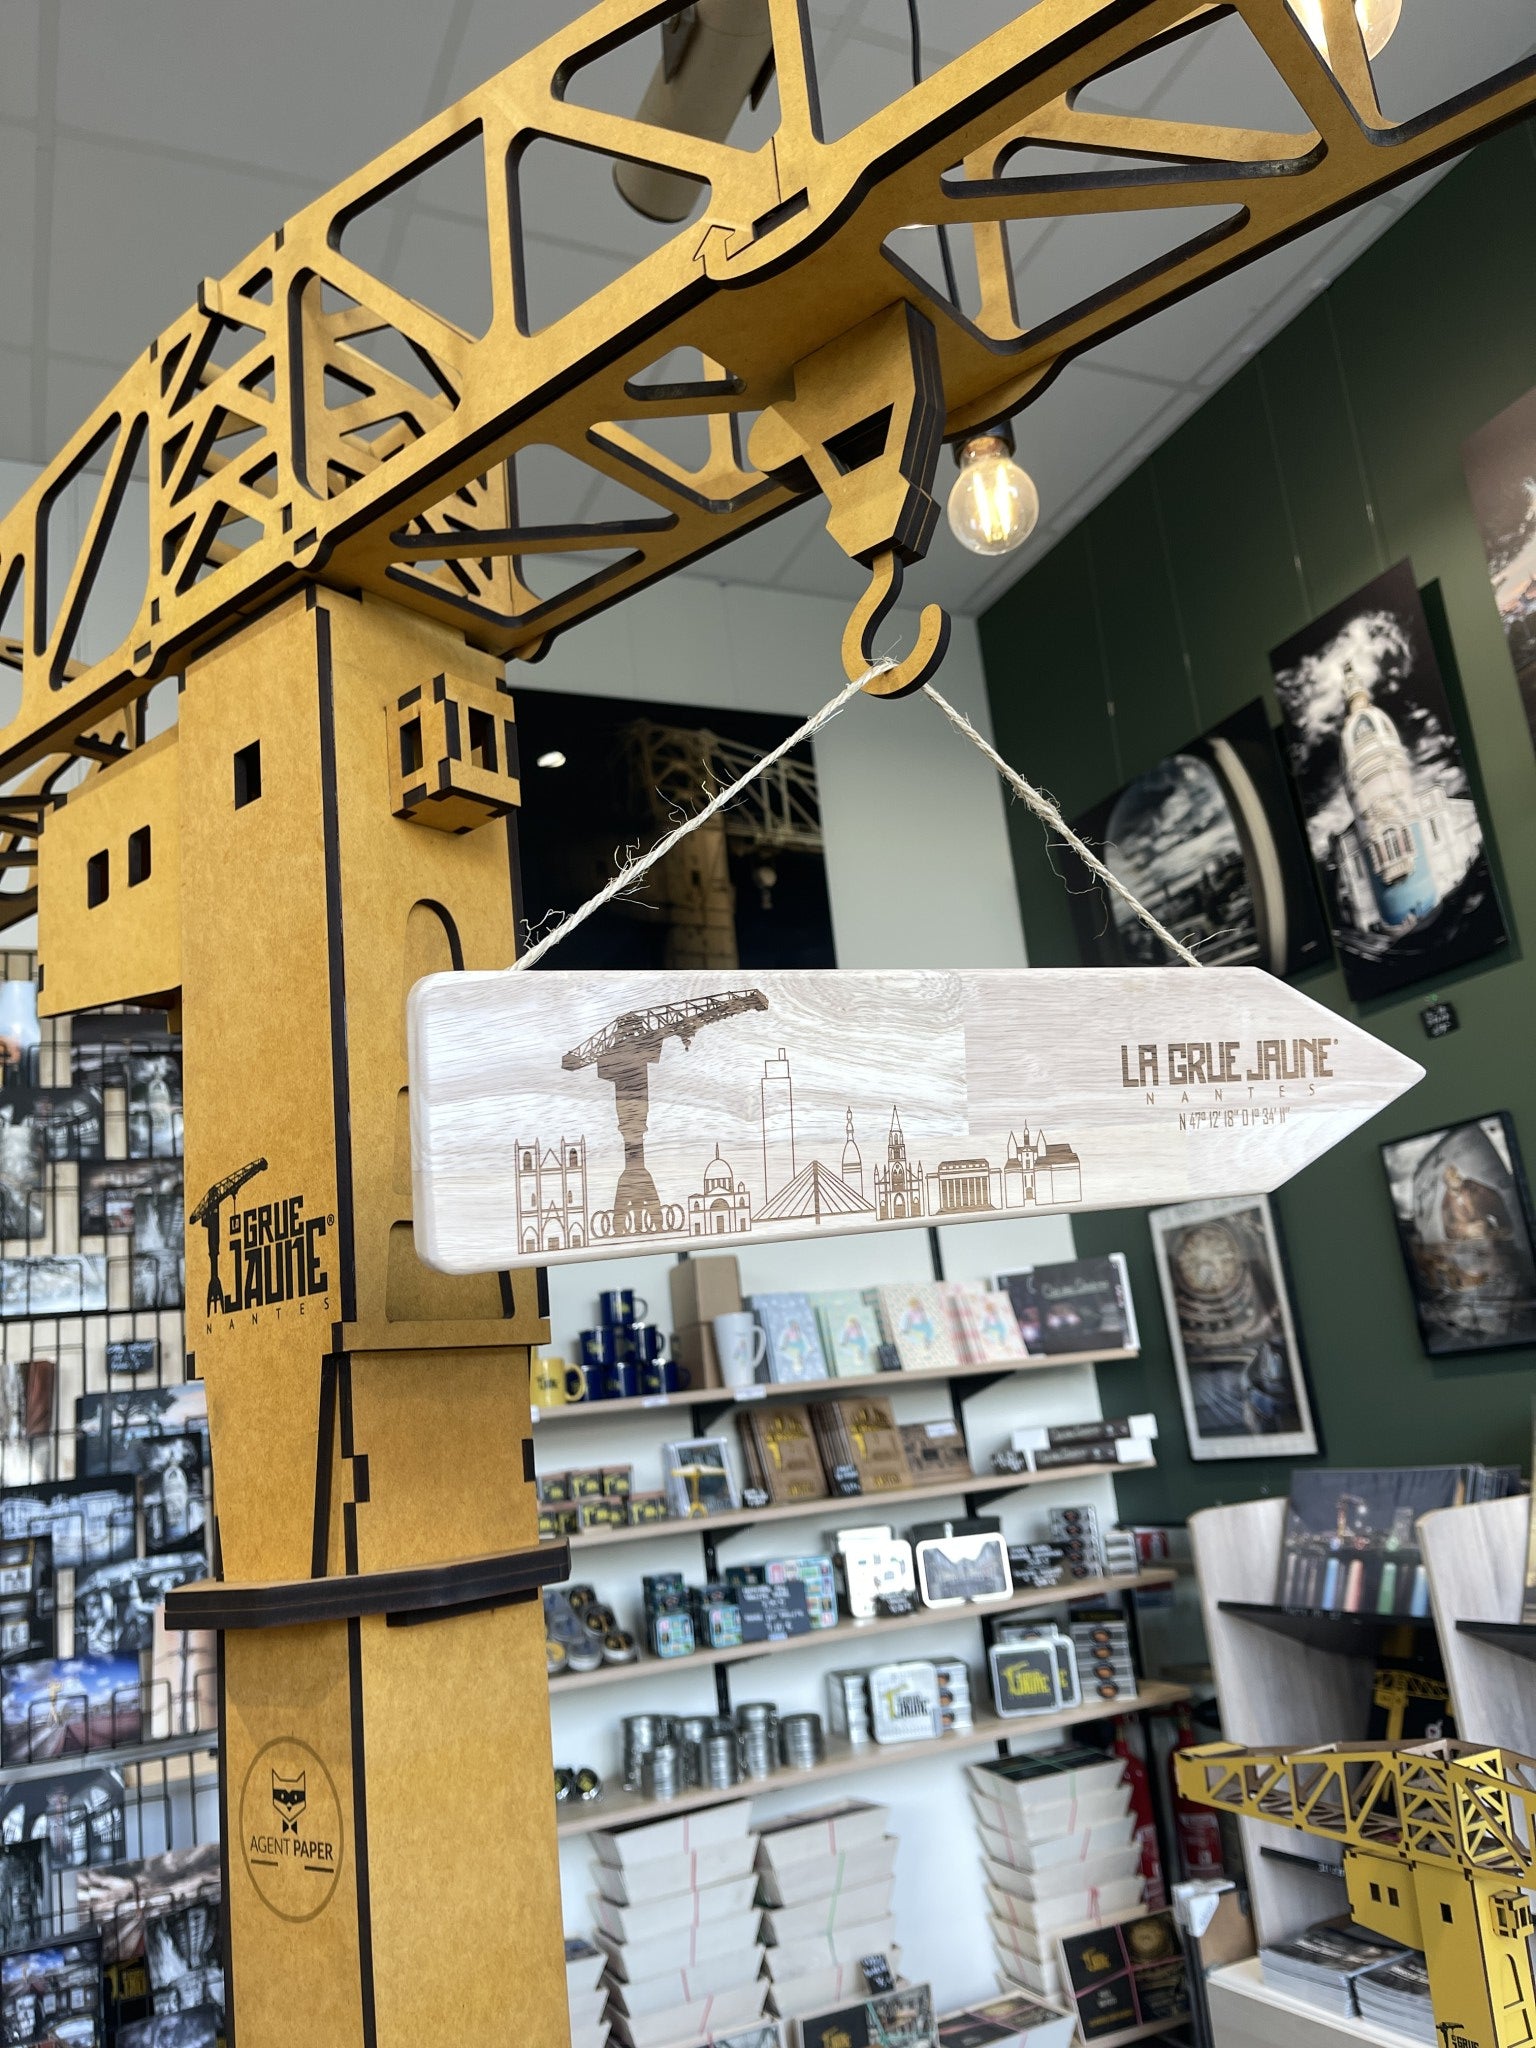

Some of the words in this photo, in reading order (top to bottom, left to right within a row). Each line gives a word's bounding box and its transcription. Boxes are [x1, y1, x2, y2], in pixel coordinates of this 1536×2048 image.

[1121, 1044, 1159, 1088] LA
[1168, 1041, 1242, 1085] GRUE
[1146, 1083, 1316, 1105] NANTES
[1179, 1113, 1186, 1131] N
[243, 1195, 304, 1250] GRUE
[206, 1297, 330, 1335] NANTES
[250, 1835, 291, 1856] AGENT
[293, 1839, 334, 1861] PAPER
